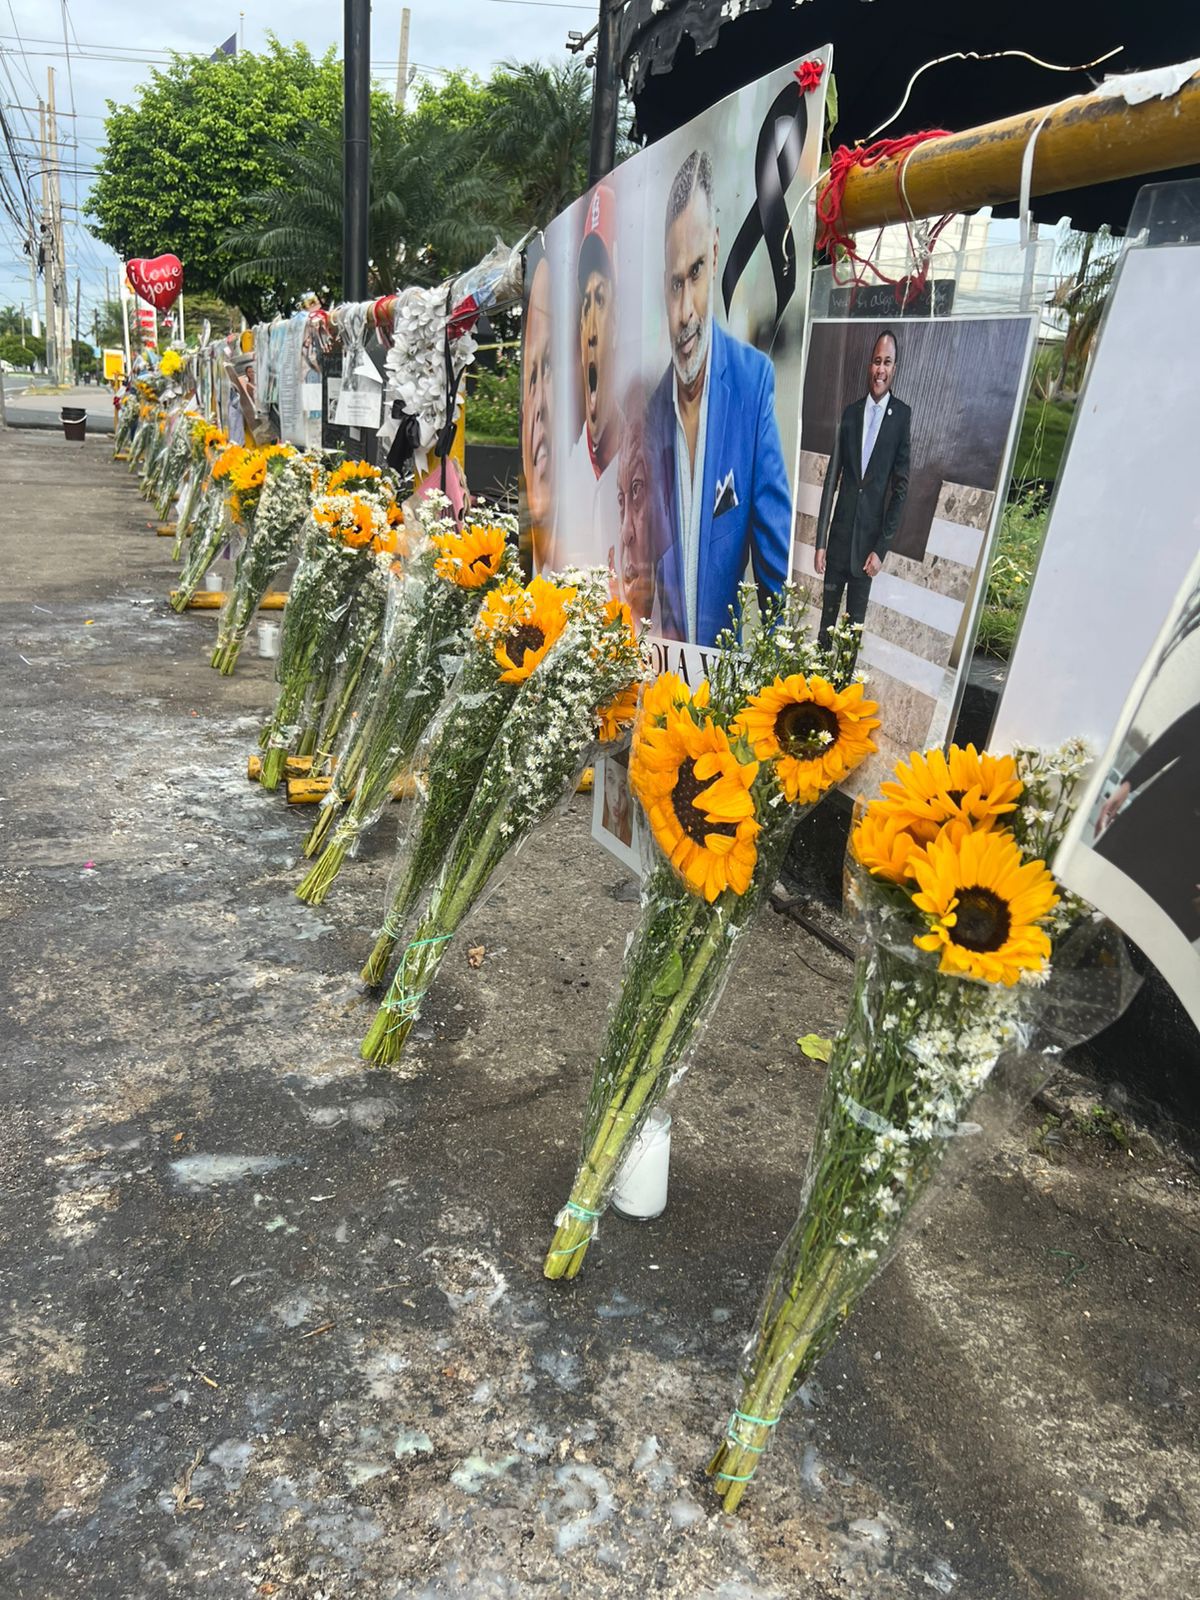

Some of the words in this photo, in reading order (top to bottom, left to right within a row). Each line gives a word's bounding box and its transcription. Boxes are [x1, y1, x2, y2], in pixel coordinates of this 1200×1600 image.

[130, 265, 139, 284] i
[139, 260, 181, 283] love
[141, 280, 177, 305] you
[639, 640, 691, 687] OLA
